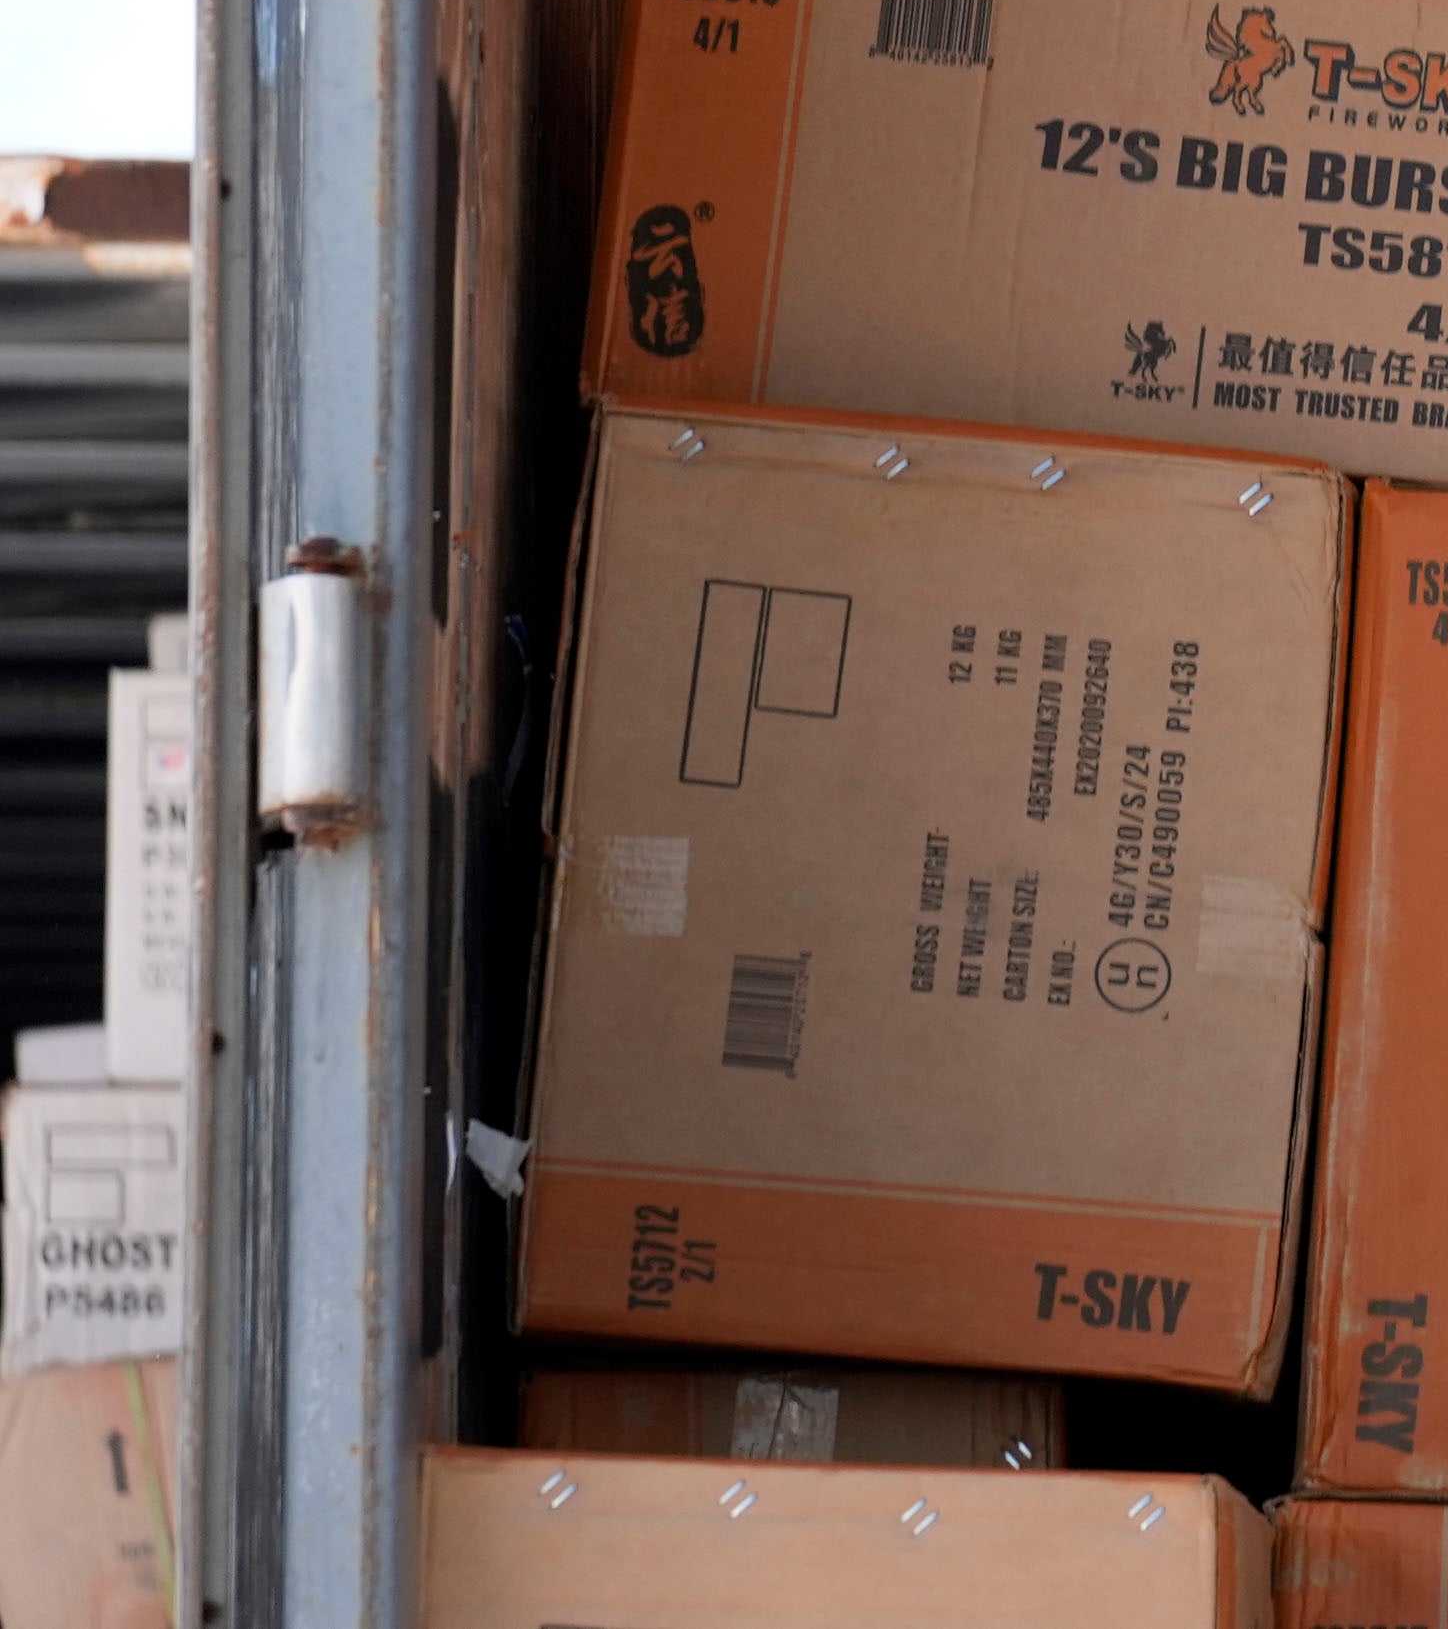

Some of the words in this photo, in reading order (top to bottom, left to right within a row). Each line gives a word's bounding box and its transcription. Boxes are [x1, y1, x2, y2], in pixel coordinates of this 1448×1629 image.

[693, 17, 739, 52] 4/1
[1035, 119, 1160, 182] 12'S
[1177, 136, 1287, 197] BIG
[1214, 382, 1281, 411] MOST
[1295, 389, 1398, 423] TRUSTED
[952, 625, 976, 653] KG
[997, 630, 1022, 657] KG
[949, 662, 972, 683] 12
[995, 667, 1017, 685] 11
[1108, 746, 1155, 930] 4G/Y30/S/24
[1139, 746, 1185, 930] CN/C490059
[910, 925, 940, 992] GROSS
[957, 961, 981, 997] NET
[1003, 922, 1033, 1001] CARTON
[1048, 983, 1072, 1006] EX
[42, 1235, 174, 1269] GHOST
[627, 1205, 679, 1310] TS5712
[680, 1240, 716, 1283] 2/1
[1035, 1263, 1190, 1335] T-SKY
[1355, 1295, 1428, 1454] T-SKY
